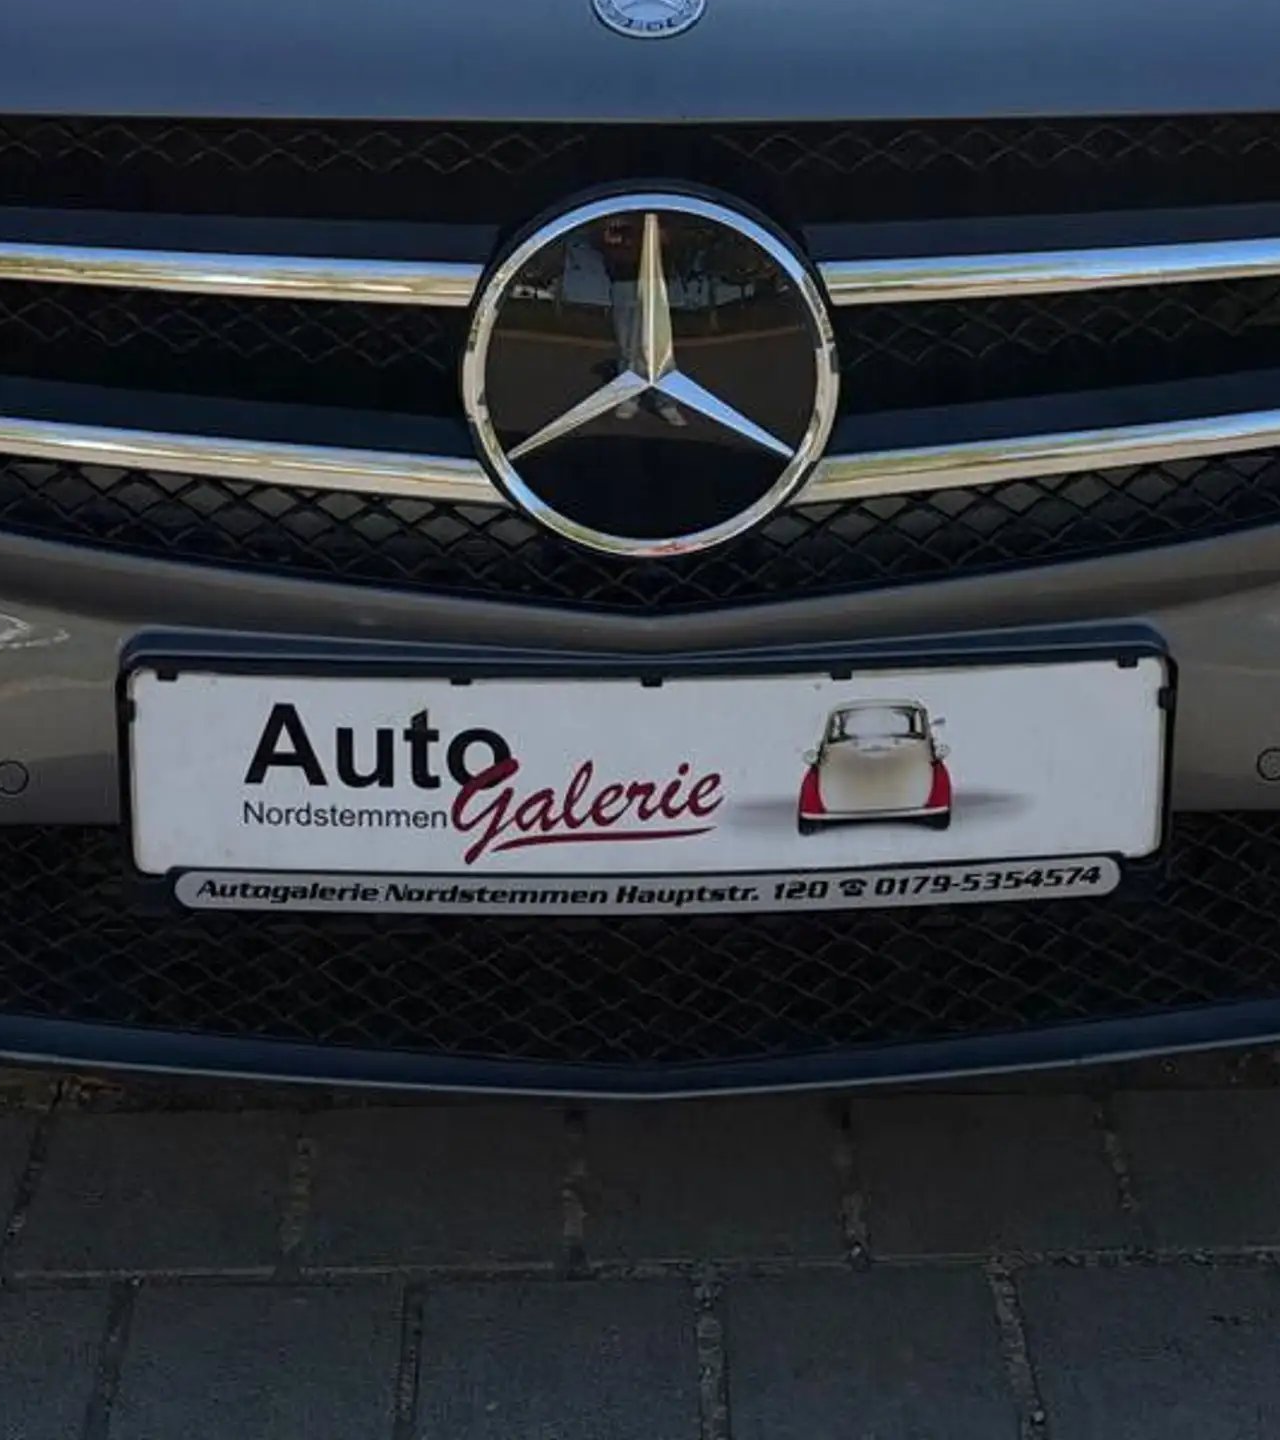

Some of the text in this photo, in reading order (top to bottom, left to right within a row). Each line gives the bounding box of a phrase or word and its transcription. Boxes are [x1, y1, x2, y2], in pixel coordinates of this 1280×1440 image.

[243, 702, 513, 790] Auto
[243, 799, 448, 829] Nordstemmen
[451, 757, 725, 865] Galerie
[196, 865, 1103, 906] Autogalerie Nordstemmen Hauptstr. 120 0179-5354574
